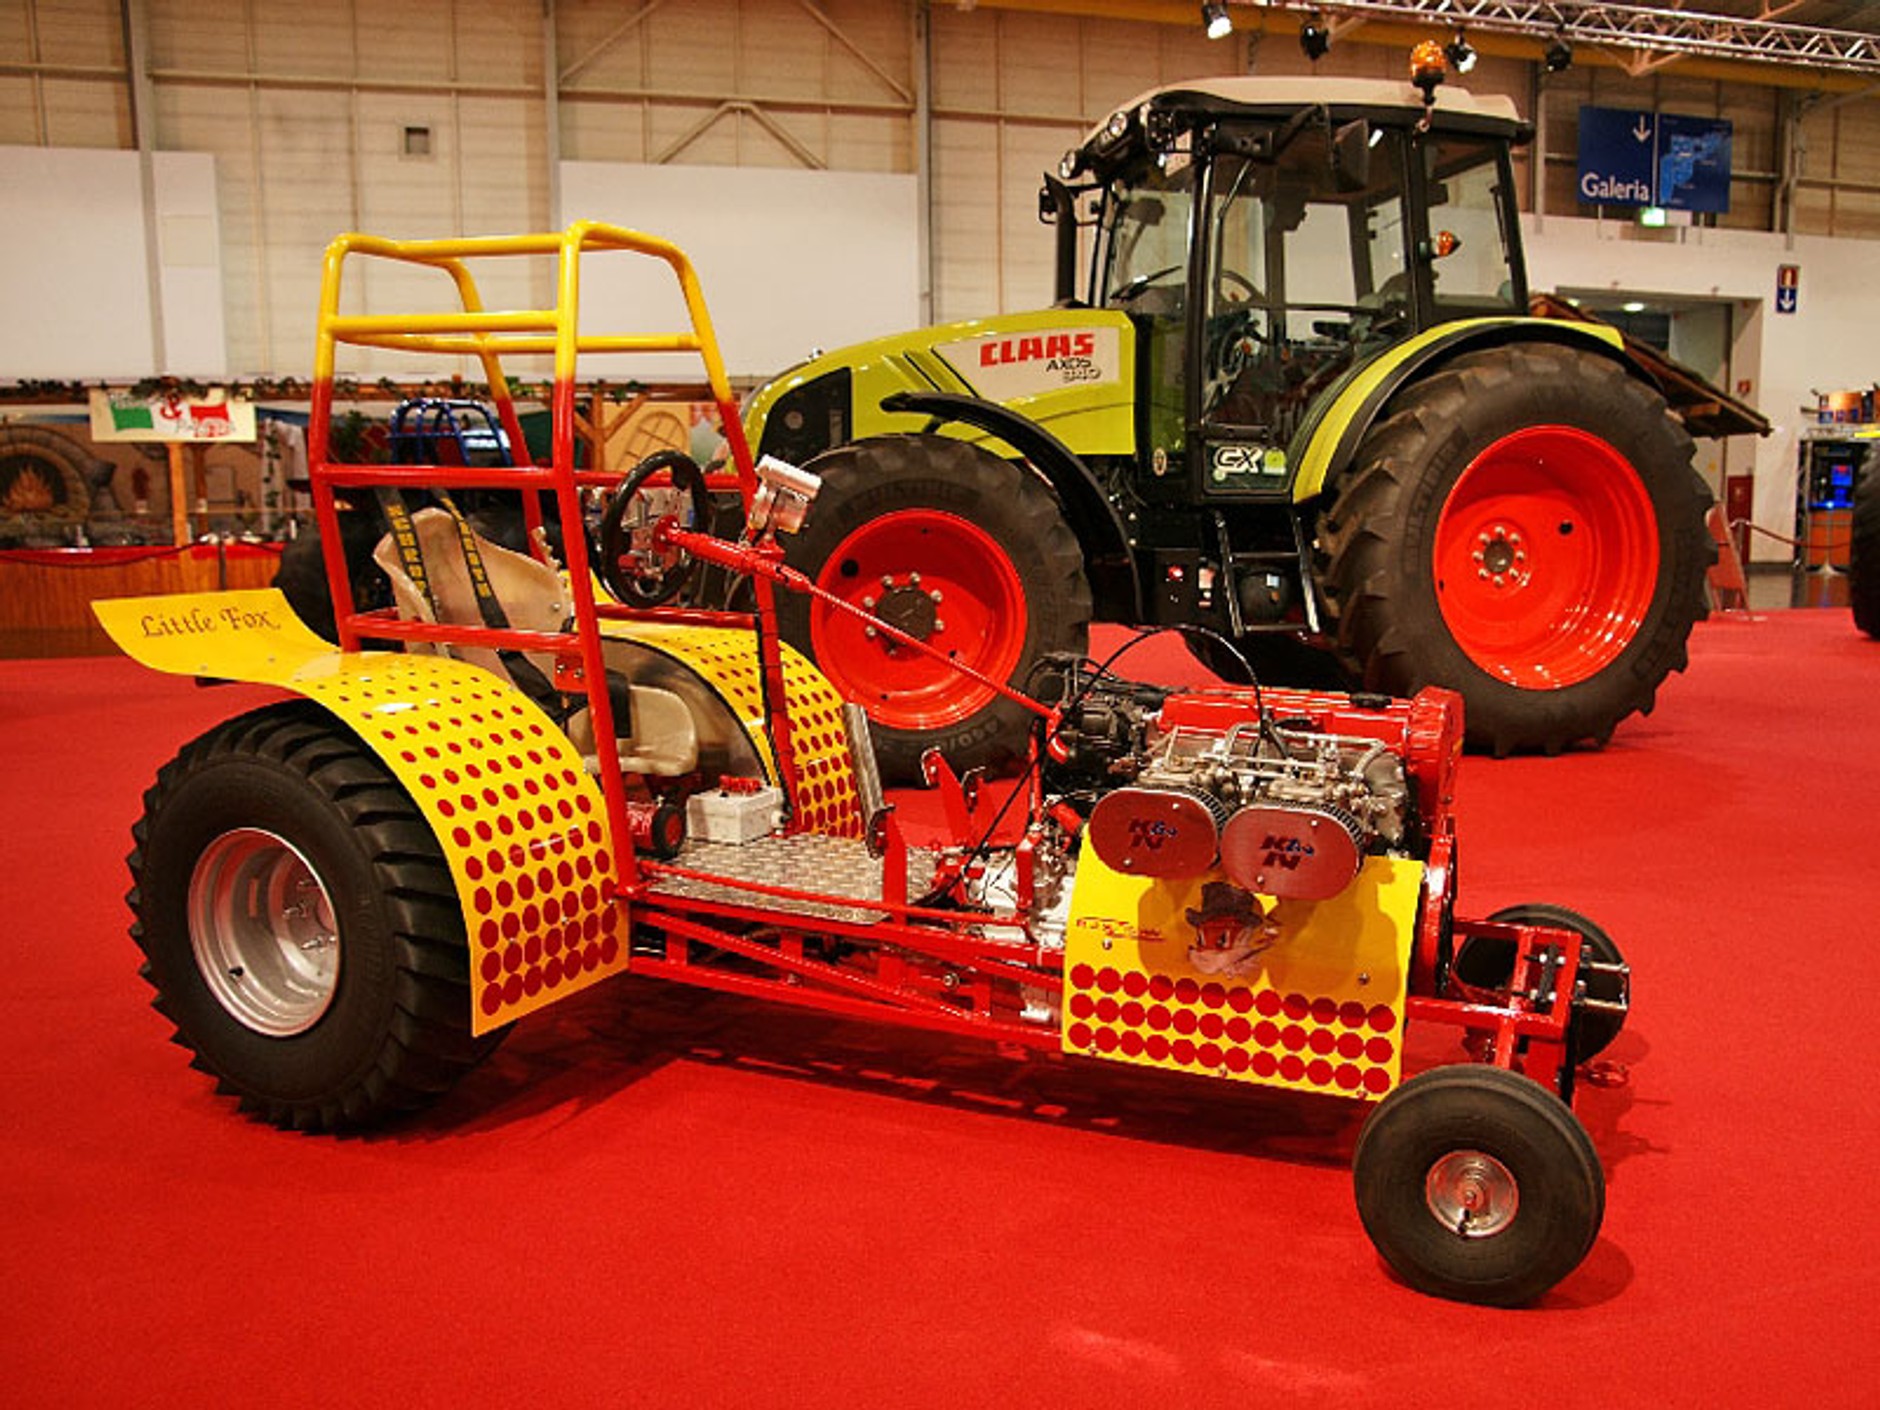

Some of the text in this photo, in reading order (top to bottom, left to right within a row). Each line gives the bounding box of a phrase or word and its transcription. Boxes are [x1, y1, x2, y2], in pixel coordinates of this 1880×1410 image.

[1581, 171, 1650, 202] Galeria
[980, 332, 1094, 368] CLAAS
[1046, 357, 1093, 373] AXOS
[140, 606, 282, 638] Little Fox
